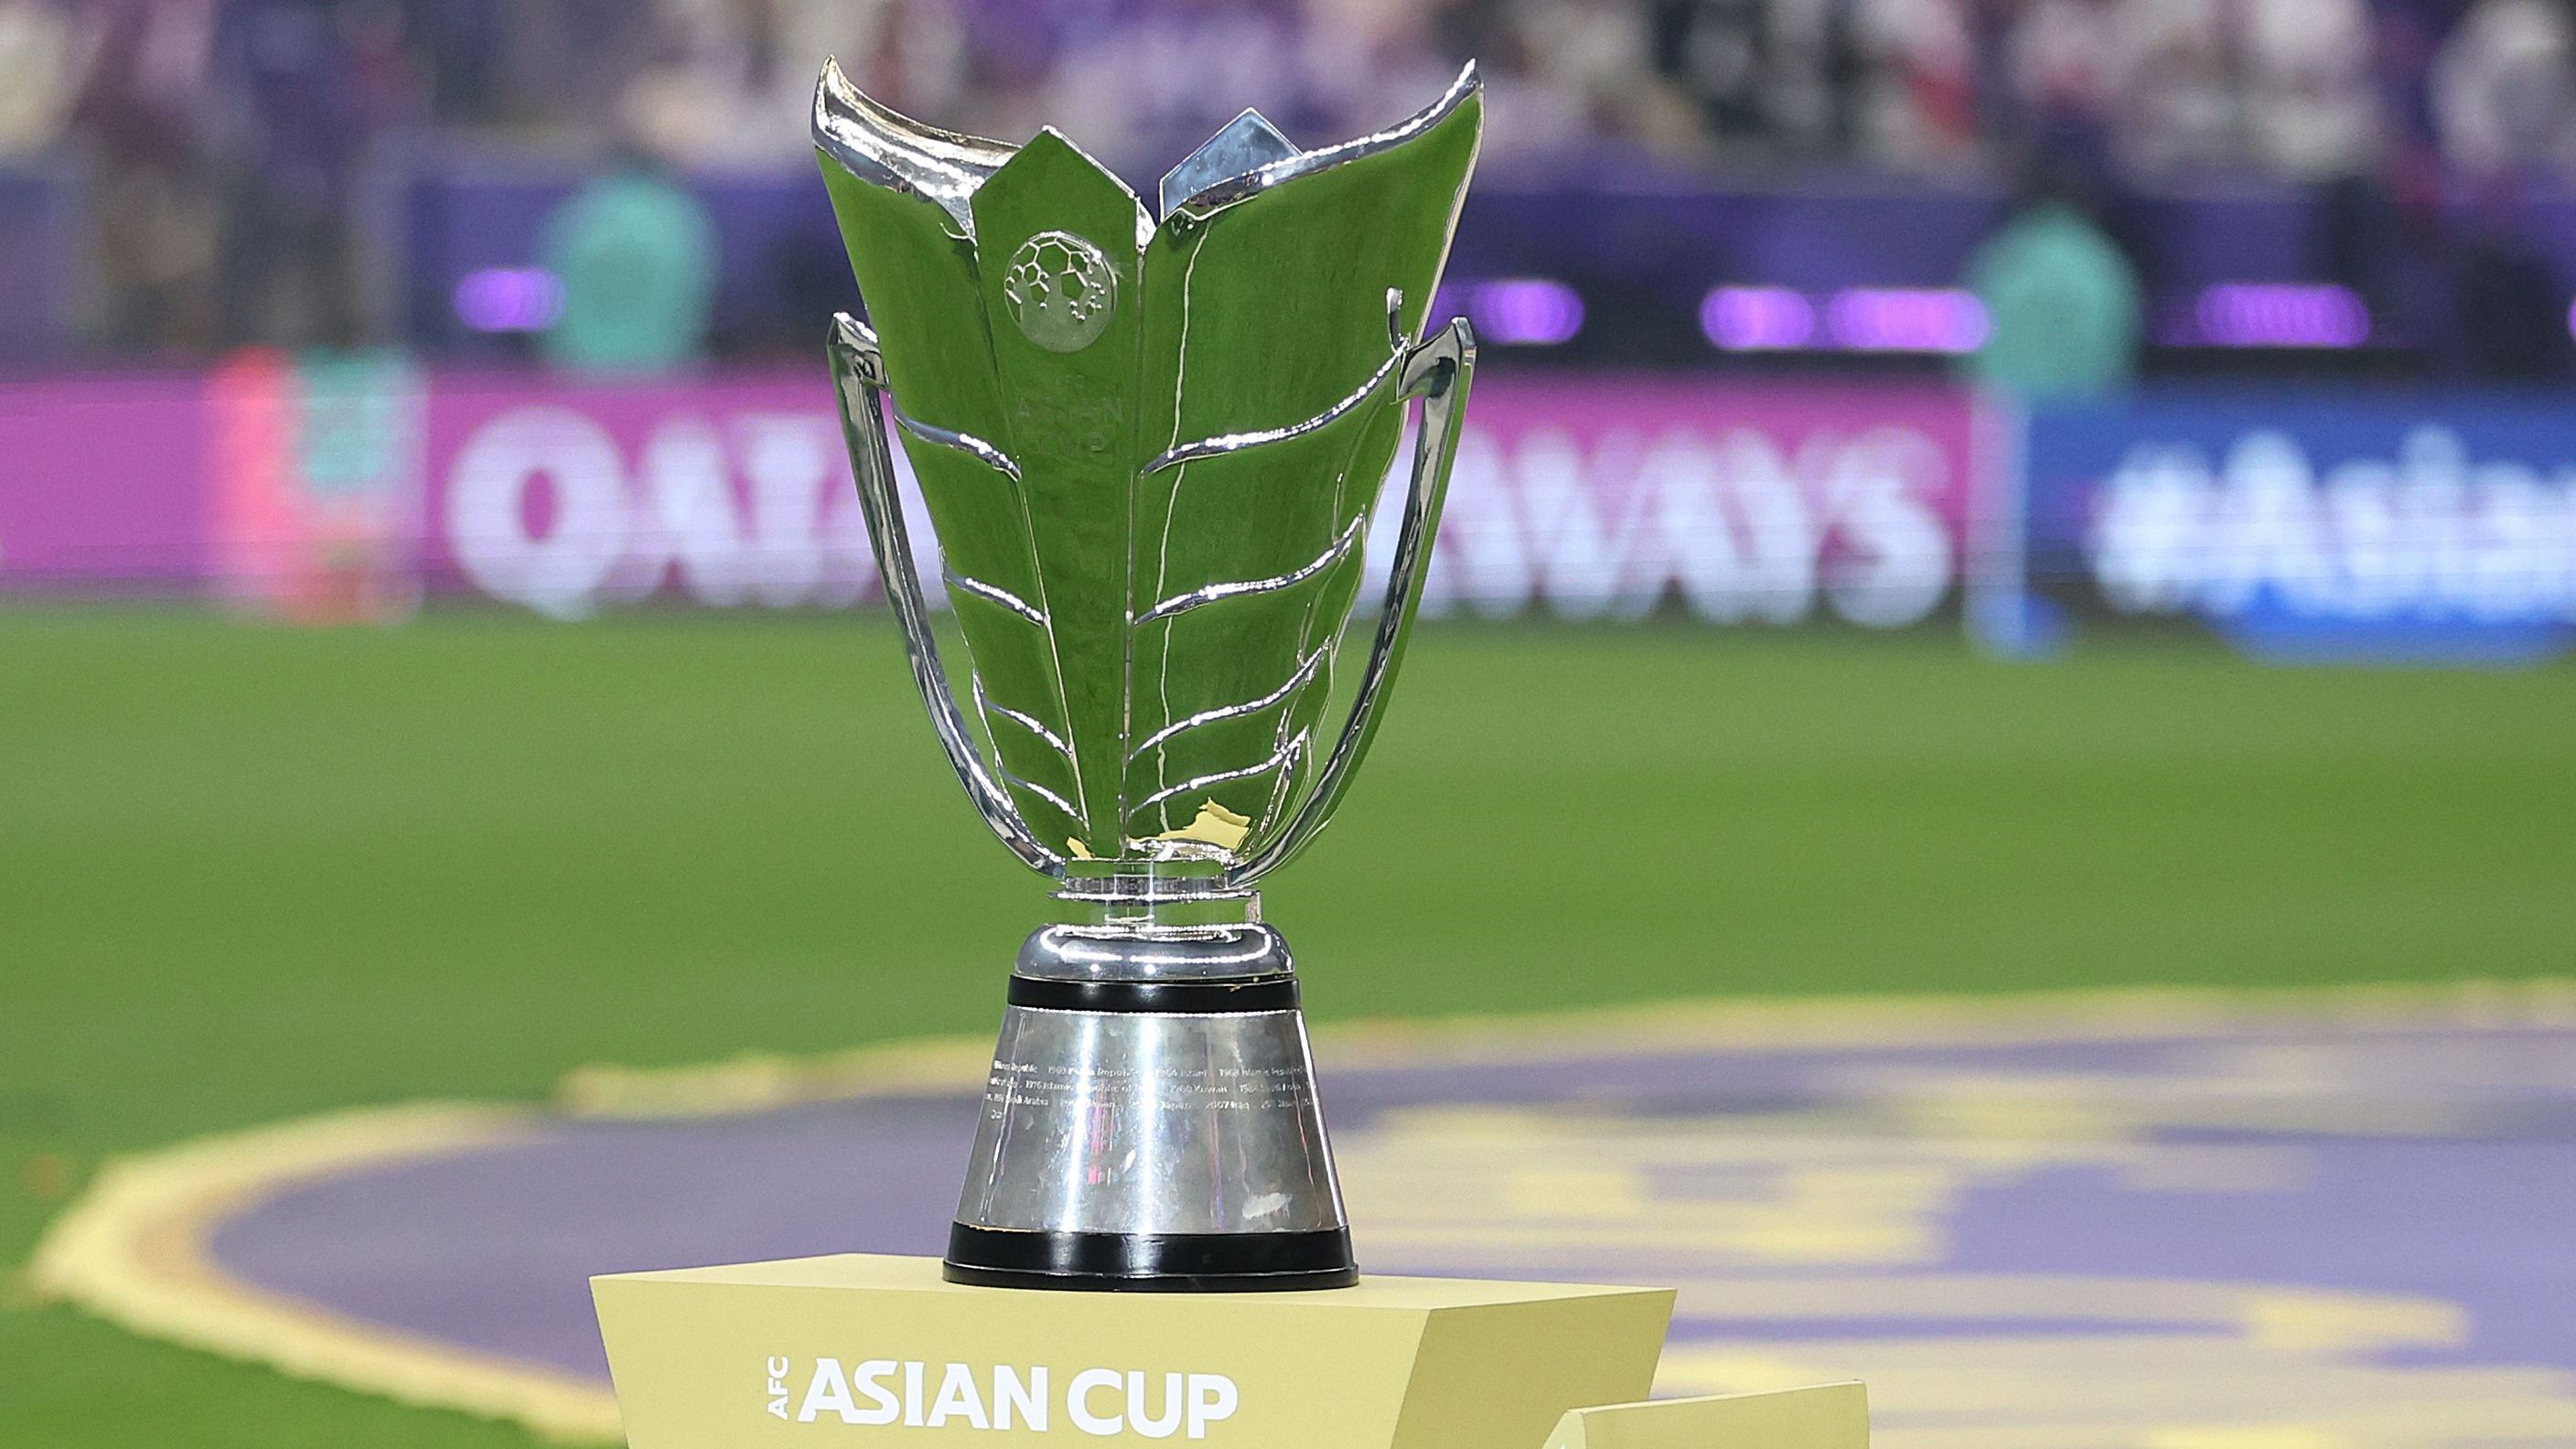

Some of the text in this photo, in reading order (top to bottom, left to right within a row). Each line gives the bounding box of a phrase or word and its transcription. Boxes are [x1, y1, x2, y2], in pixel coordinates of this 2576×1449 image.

[448, 406, 956, 622] QATA
[767, 1356, 789, 1421] AFC
[797, 1358, 1239, 1439] ASIAN CUP
